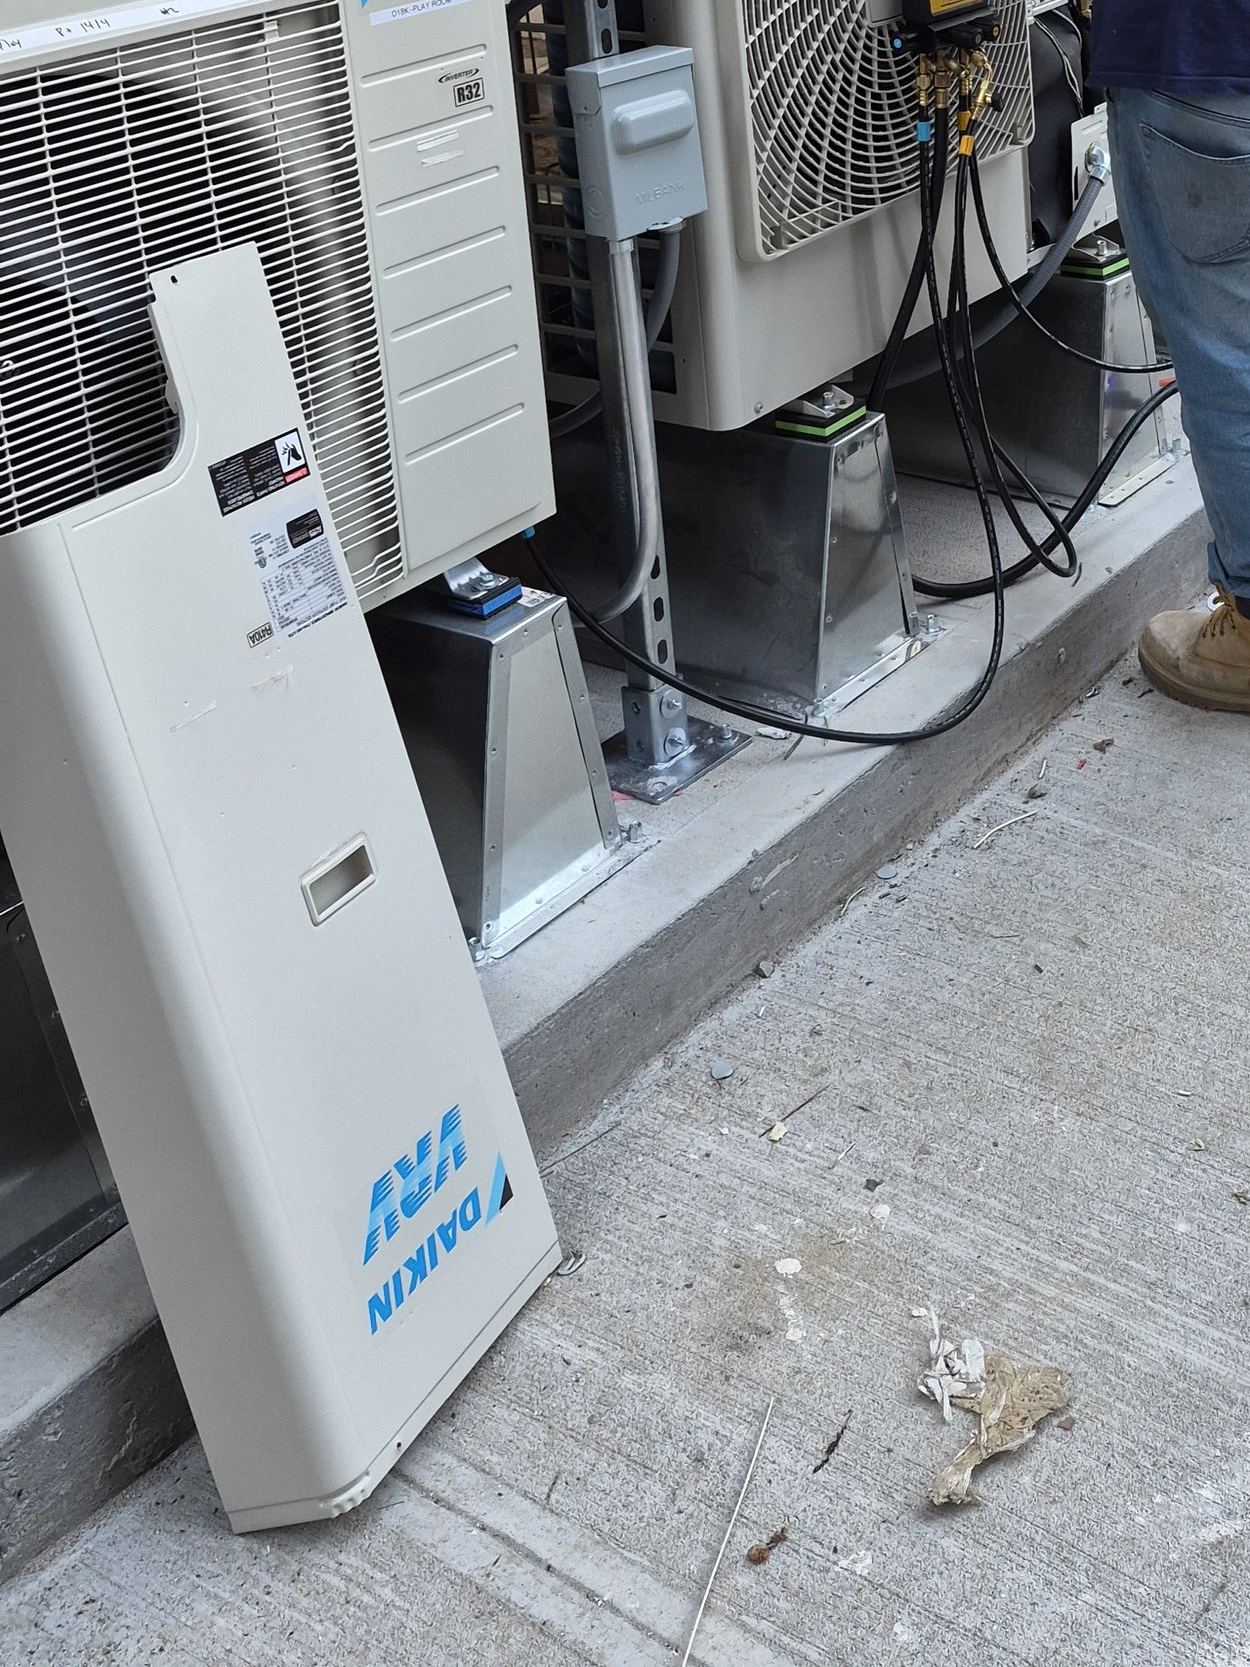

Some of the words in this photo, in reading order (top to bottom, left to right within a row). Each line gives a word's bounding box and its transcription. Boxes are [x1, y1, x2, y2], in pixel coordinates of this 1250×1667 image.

[444, 68, 474, 83] INVERTER
[456, 81, 482, 103] R32
[635, 181, 687, 204] MILBANK
[248, 624, 273, 645] R410A
[362, 1102, 468, 1267] VRV
[366, 1185, 482, 1336] DAIKIN
